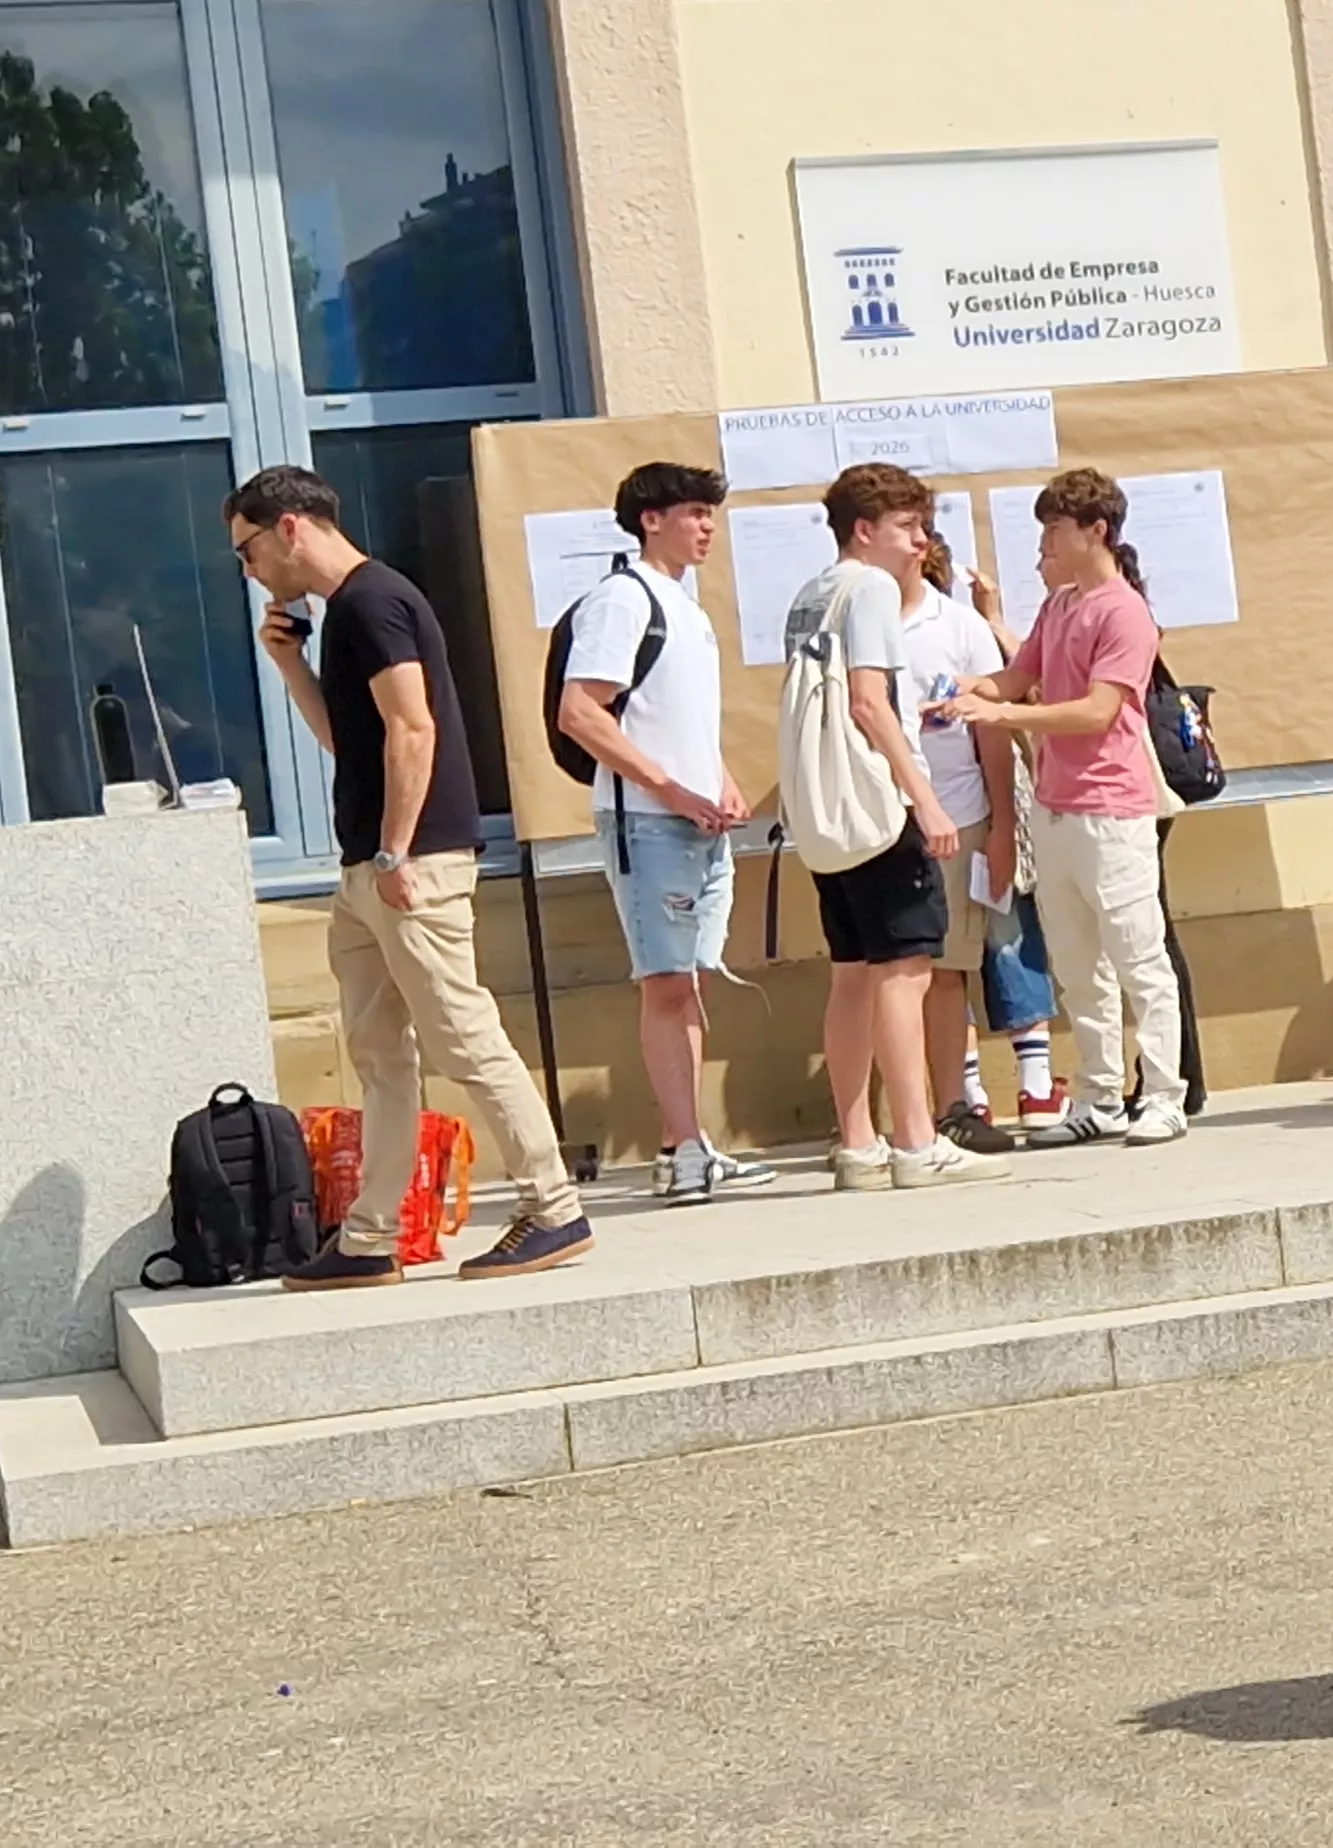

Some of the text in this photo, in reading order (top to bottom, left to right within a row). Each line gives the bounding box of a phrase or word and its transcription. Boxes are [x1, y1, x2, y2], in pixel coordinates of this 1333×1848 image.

[945, 259, 1160, 286] Facultad de Empresa
[948, 299, 960, 318] y
[964, 291, 1046, 314] Gestión
[1051, 285, 1127, 308] Pública
[1143, 283, 1216, 304] Huesca
[953, 315, 1222, 348] Universidad Zaragoza
[725, 396, 1051, 432] PRUEBAS DE ACCESO A LA UNIVERSIDAD
